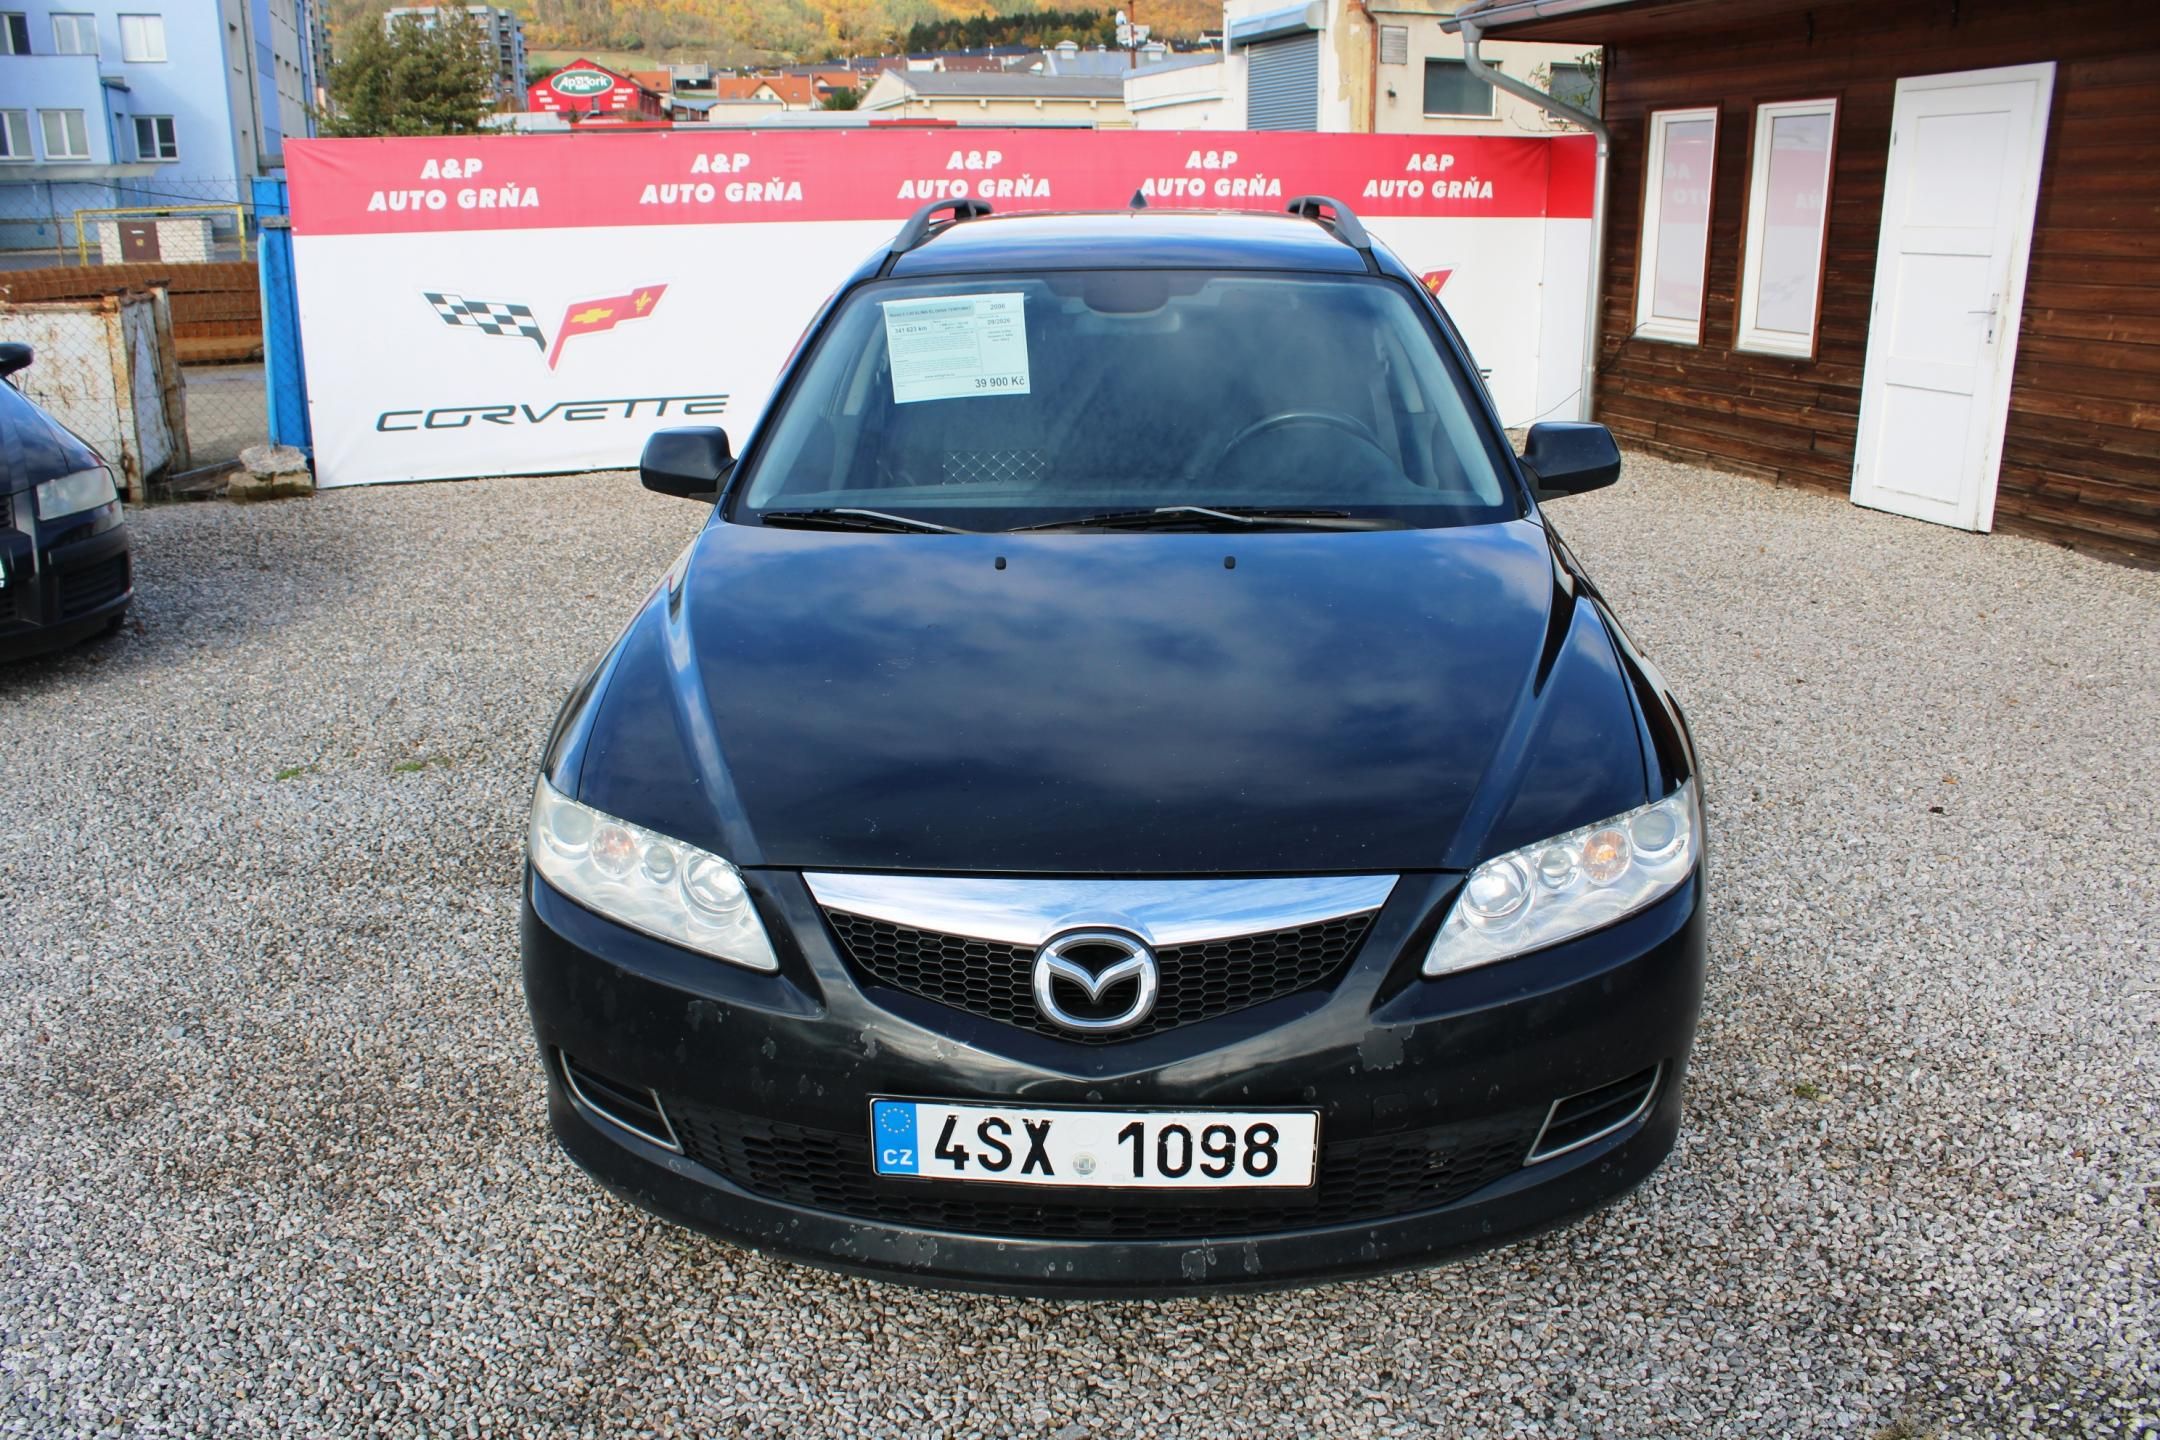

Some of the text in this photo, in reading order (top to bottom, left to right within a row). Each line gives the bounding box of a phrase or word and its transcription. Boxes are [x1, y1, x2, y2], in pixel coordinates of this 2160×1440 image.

[420, 158, 483, 180] A&P
[690, 153, 750, 174] A&P
[946, 150, 1002, 170] A&P
[1185, 150, 1238, 169] A&P
[1406, 153, 1455, 172] A&P
[367, 182, 540, 212] AUTO GRŇA
[639, 176, 803, 205] AUTO GRŇA
[897, 173, 1051, 199] AUTO GRŇA
[1140, 173, 1282, 198] AUTO GRŇA
[1362, 176, 1493, 199] AUTO GRŇA
[975, 375, 1025, 389] 39 900 Kč
[376, 394, 730, 432] CORVETTE
[883, 1114, 1280, 1179] CZ 4SX 1098
